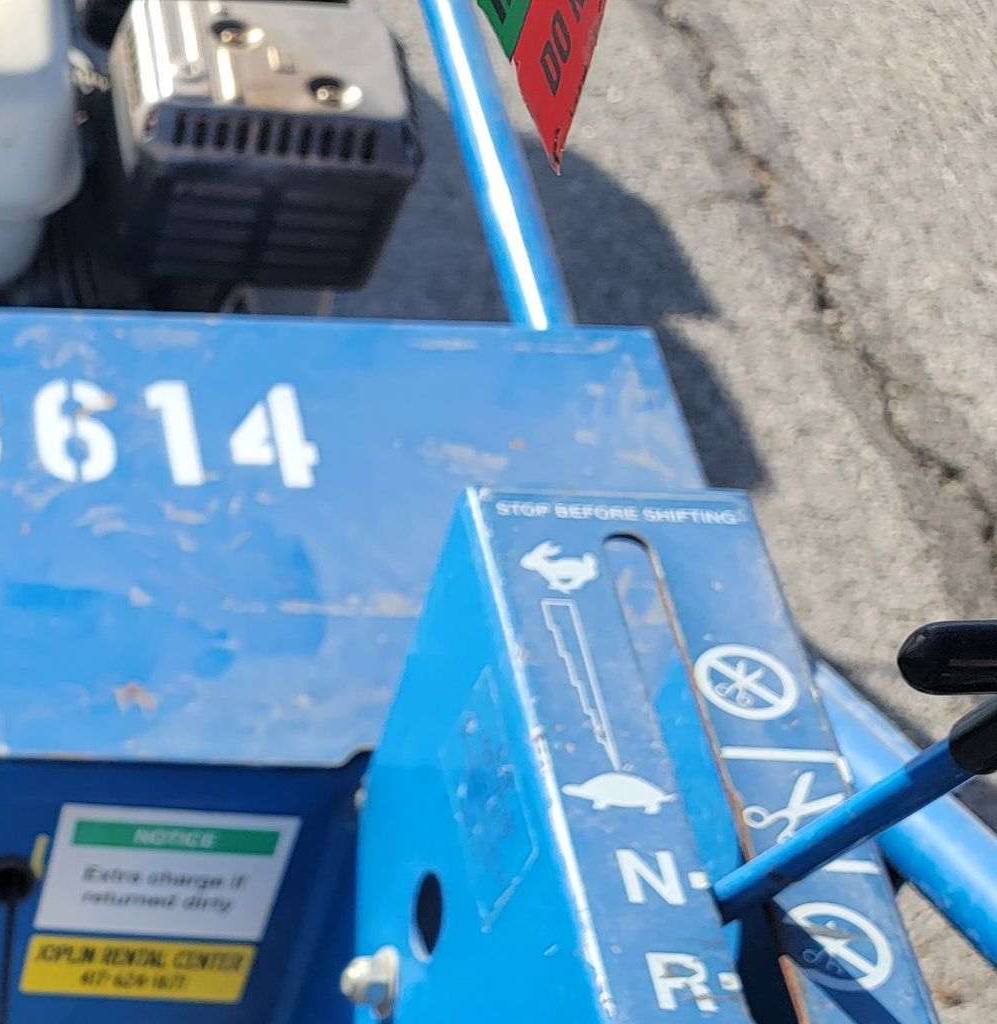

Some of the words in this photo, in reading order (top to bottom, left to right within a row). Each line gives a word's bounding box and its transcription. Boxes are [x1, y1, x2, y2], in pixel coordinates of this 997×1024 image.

[495, 500, 550, 518] STOP
[554, 502, 638, 522] BEFORE
[642, 506, 738, 525] SHIFTING
[133, 828, 218, 849] NOTICE
[82, 864, 140, 884] Extra
[147, 868, 223, 891] charge
[230, 872, 249, 890] if
[81, 890, 176, 911] returned
[181, 894, 233, 915] dirty
[102, 946, 166, 969] RENTAL
[172, 950, 244, 972] CENTER
